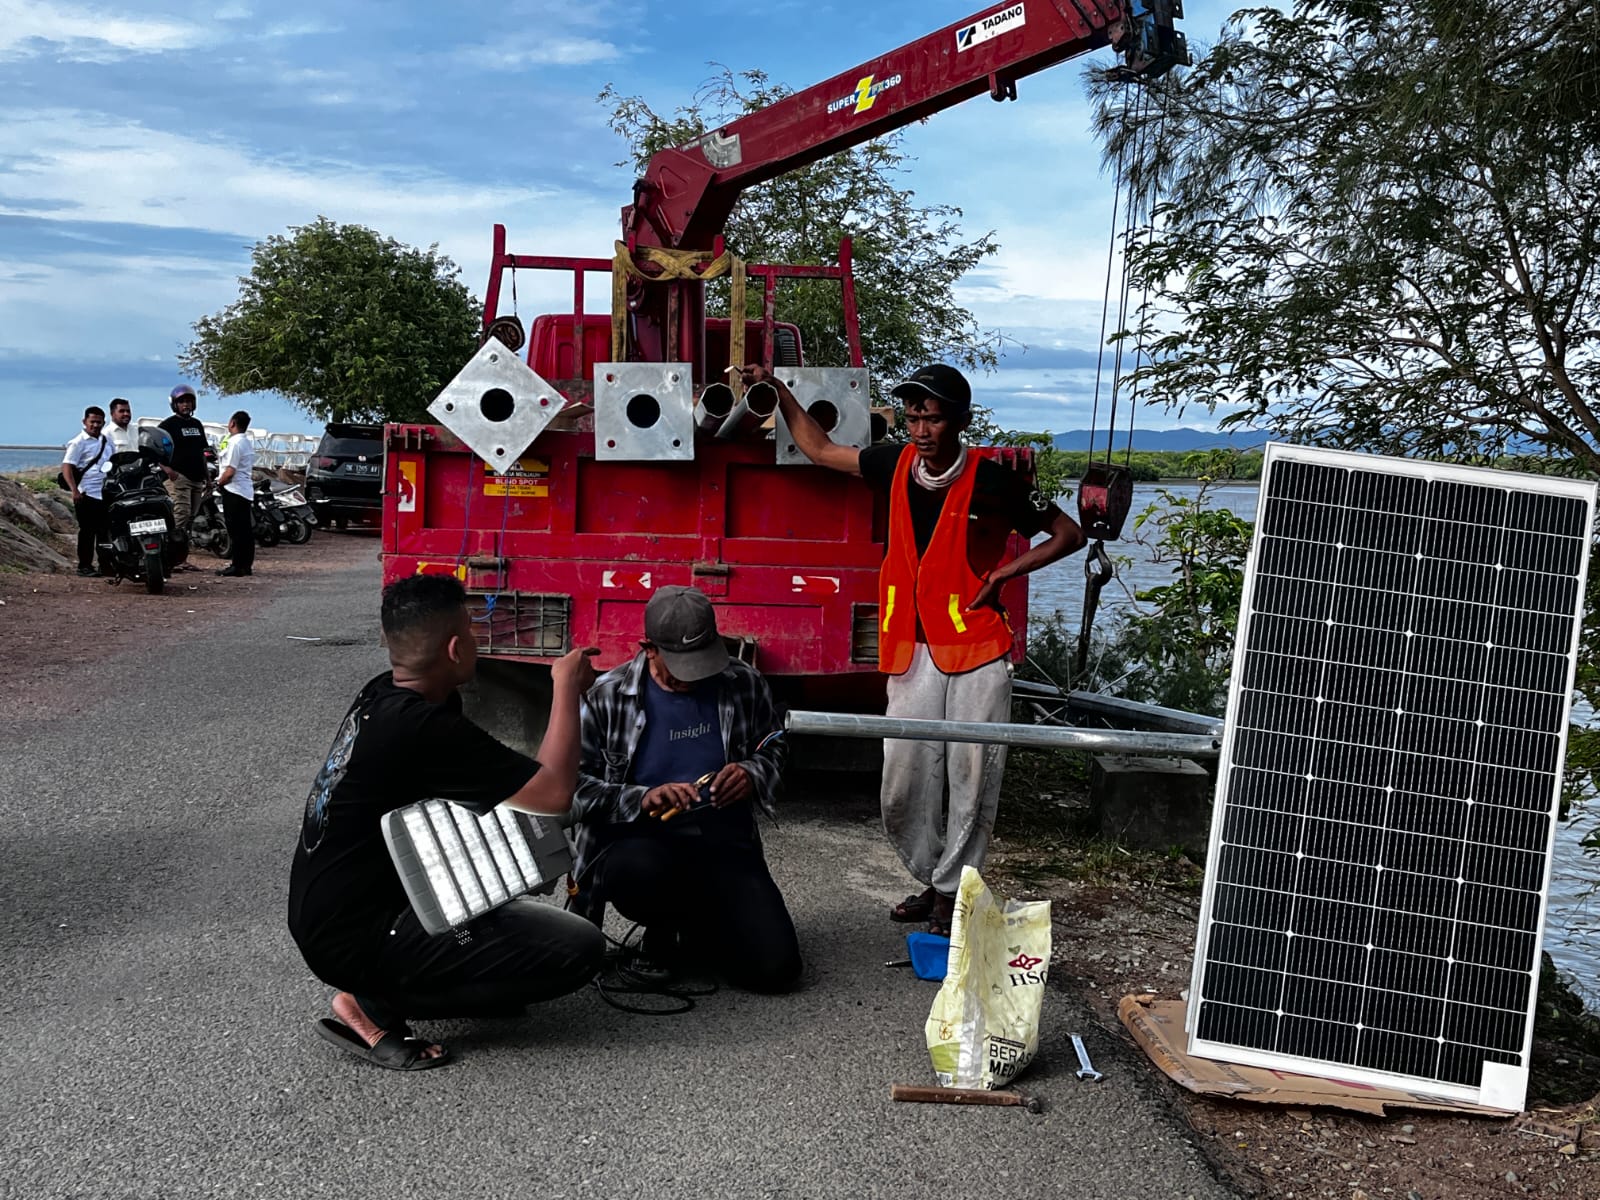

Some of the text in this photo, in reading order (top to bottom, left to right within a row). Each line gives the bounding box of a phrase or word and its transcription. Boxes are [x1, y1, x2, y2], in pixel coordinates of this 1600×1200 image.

[981, 6, 1023, 30] TADANO
[827, 93, 856, 114] SUPER
[669, 722, 712, 741] Insight
[990, 1043, 1032, 1065] BERAS
